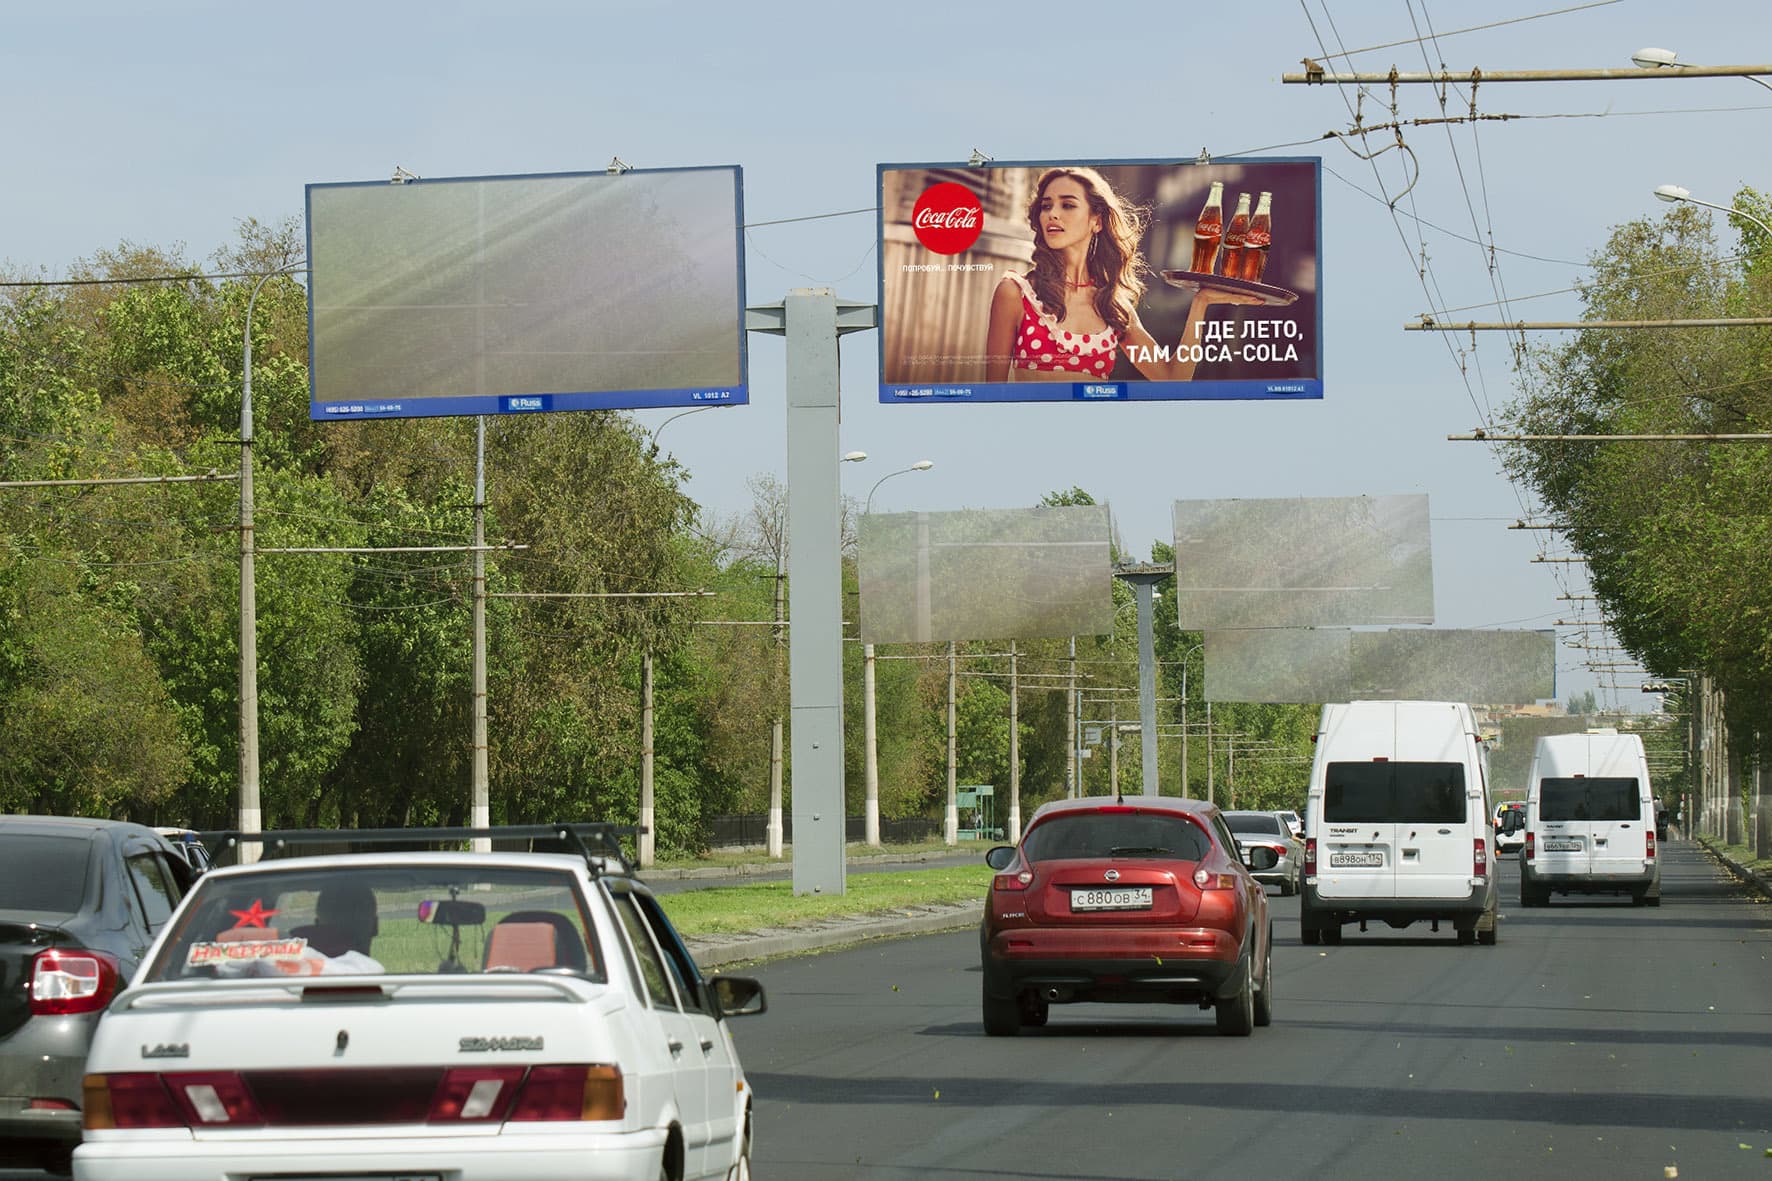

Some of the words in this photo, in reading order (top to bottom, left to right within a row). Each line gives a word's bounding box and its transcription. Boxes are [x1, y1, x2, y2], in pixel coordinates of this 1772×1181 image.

[915, 207, 980, 229] Coca-Cola
[1194, 320, 1235, 342] ГДЕ
[1240, 320, 1303, 341] ЛЕТО,
[1126, 345, 1170, 363] ТАМ
[1176, 343, 1299, 363] COCA-COLA
[1134, 889, 1148, 900] 34
